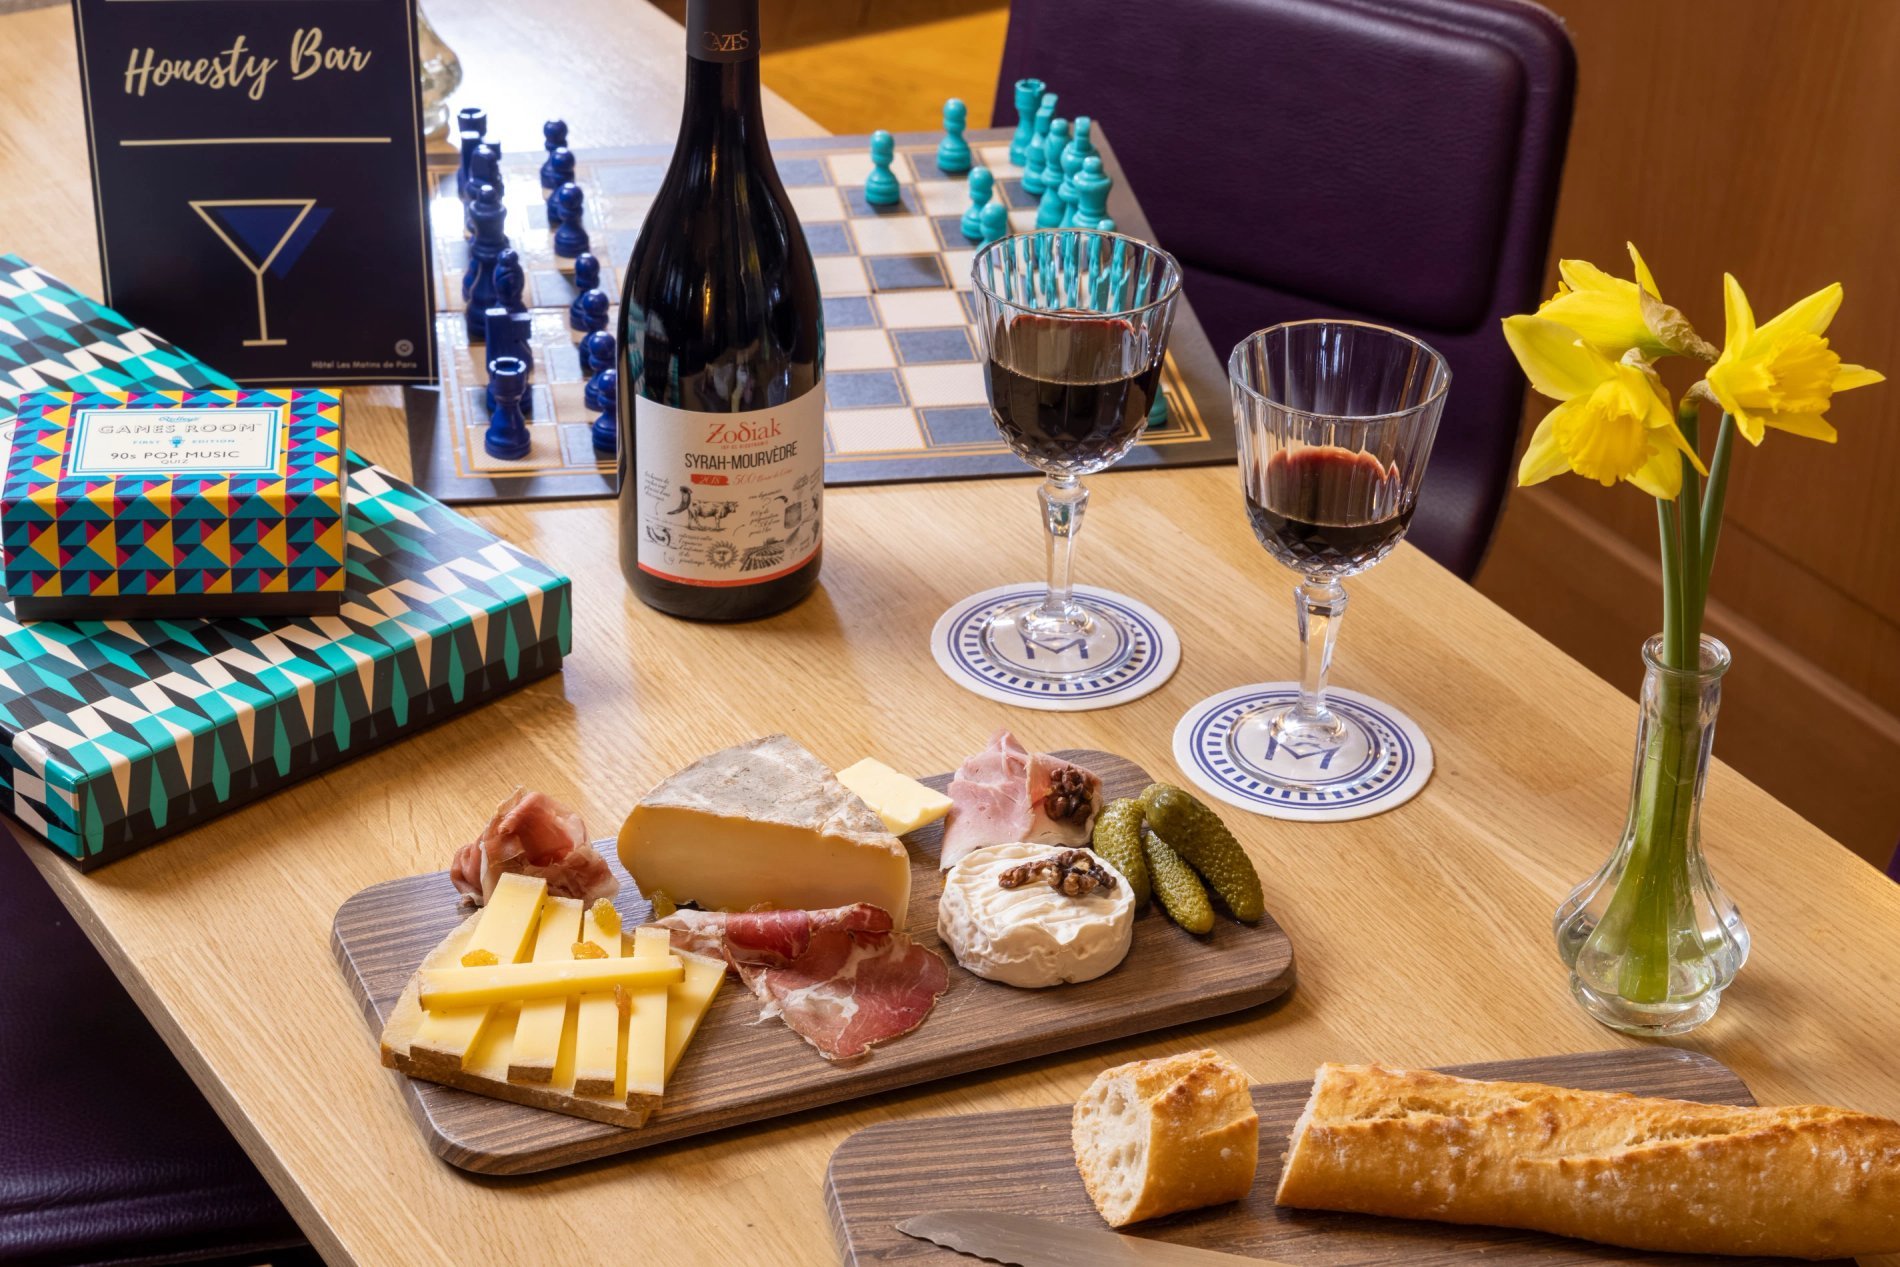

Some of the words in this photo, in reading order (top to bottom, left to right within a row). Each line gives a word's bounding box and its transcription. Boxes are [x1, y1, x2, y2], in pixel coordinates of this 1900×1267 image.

[125, 35, 278, 100] Honesty
[290, 27, 371, 80] Bar
[311, 359, 334, 369] Hôtel
[336, 360, 351, 369] Les
[352, 360, 381, 369] Matins
[383, 360, 395, 369] de
[396, 360, 418, 369] Paris
[98, 424, 176, 434] GAMES
[110, 452, 137, 460] 90s
[144, 451, 179, 460] POP
[185, 450, 241, 459] MUSIC
[684, 440, 798, 471] SYRAH-MOURVÈDRE
